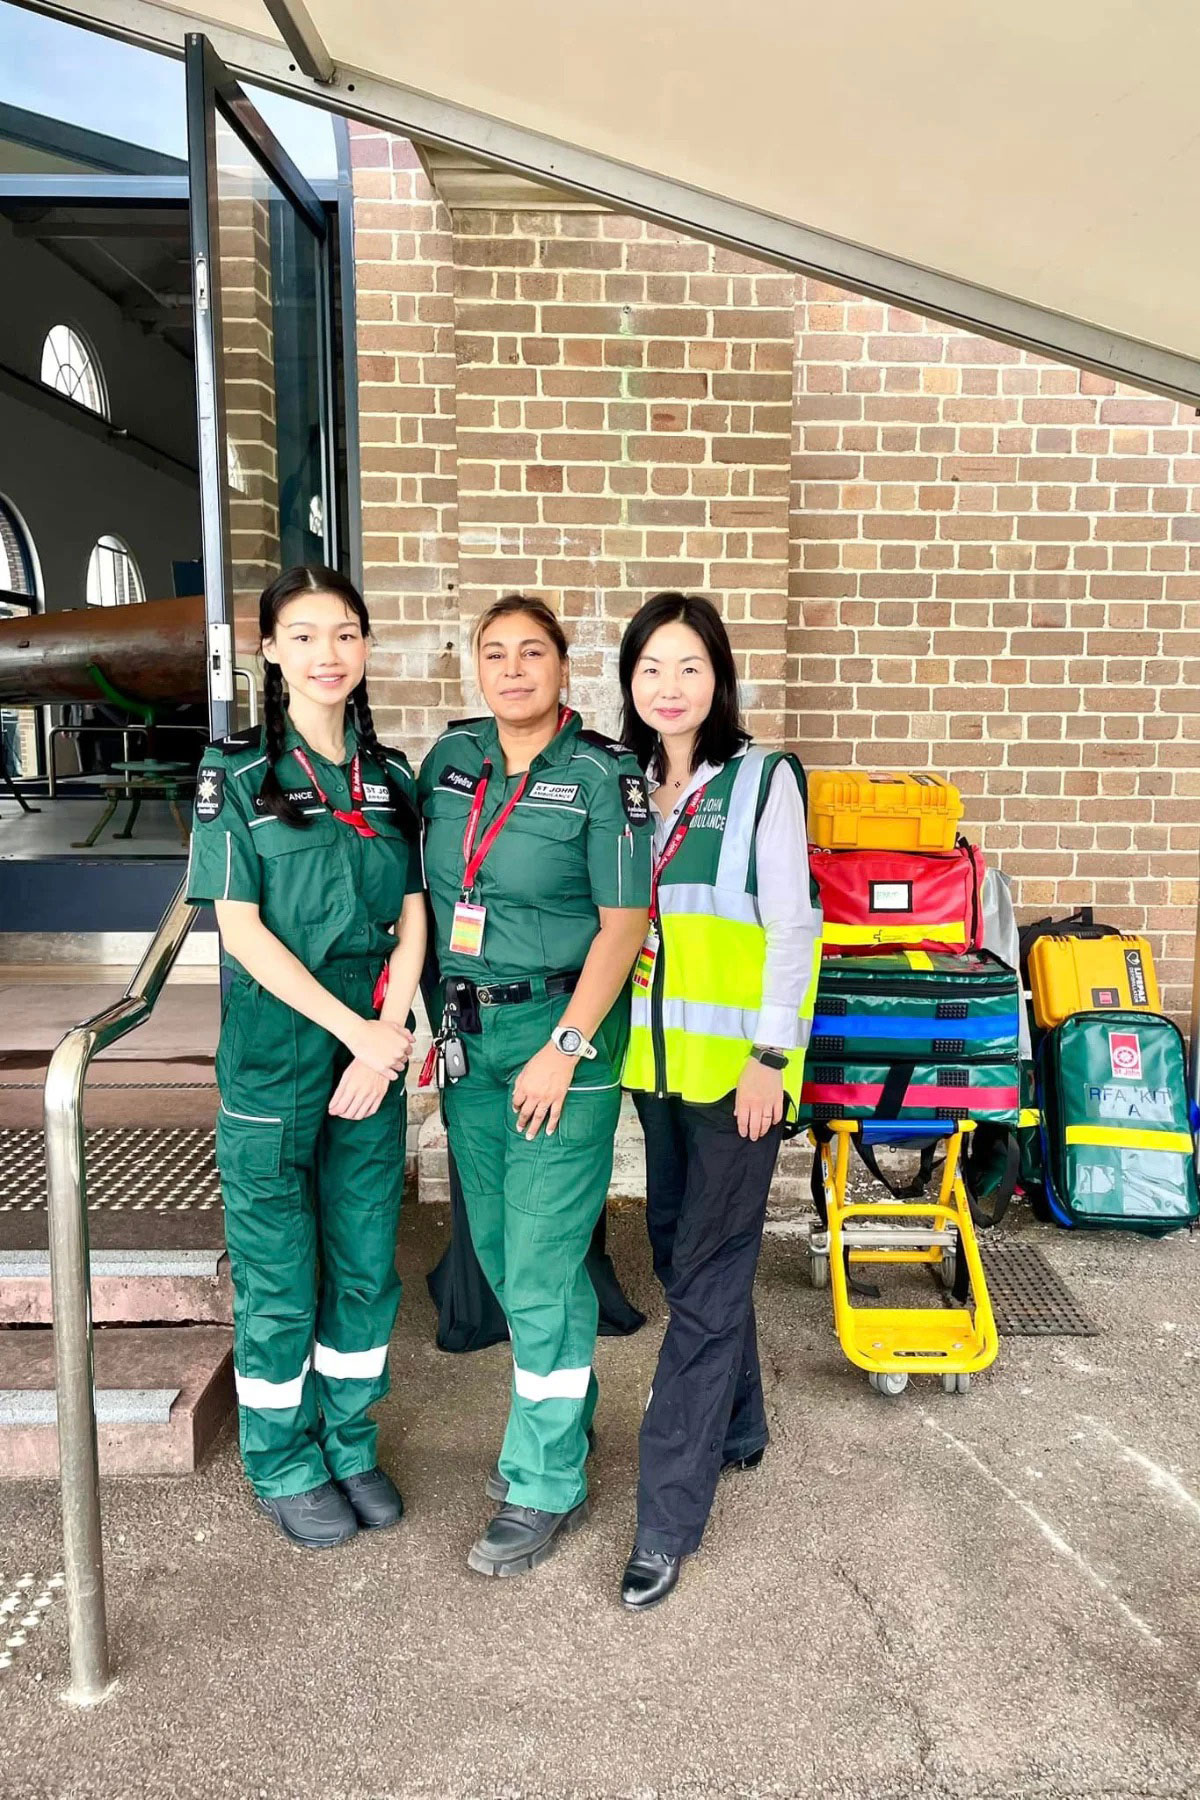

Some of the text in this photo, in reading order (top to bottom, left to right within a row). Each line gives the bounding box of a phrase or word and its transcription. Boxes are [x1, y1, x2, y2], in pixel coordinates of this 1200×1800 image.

[703, 798, 723, 812] JOHN
[1135, 967, 1147, 1003] LIFEPAK
[1124, 1068, 1140, 1077] John
[1089, 1087, 1169, 1105] RFA KIT
[1128, 1104, 1141, 1117] A
